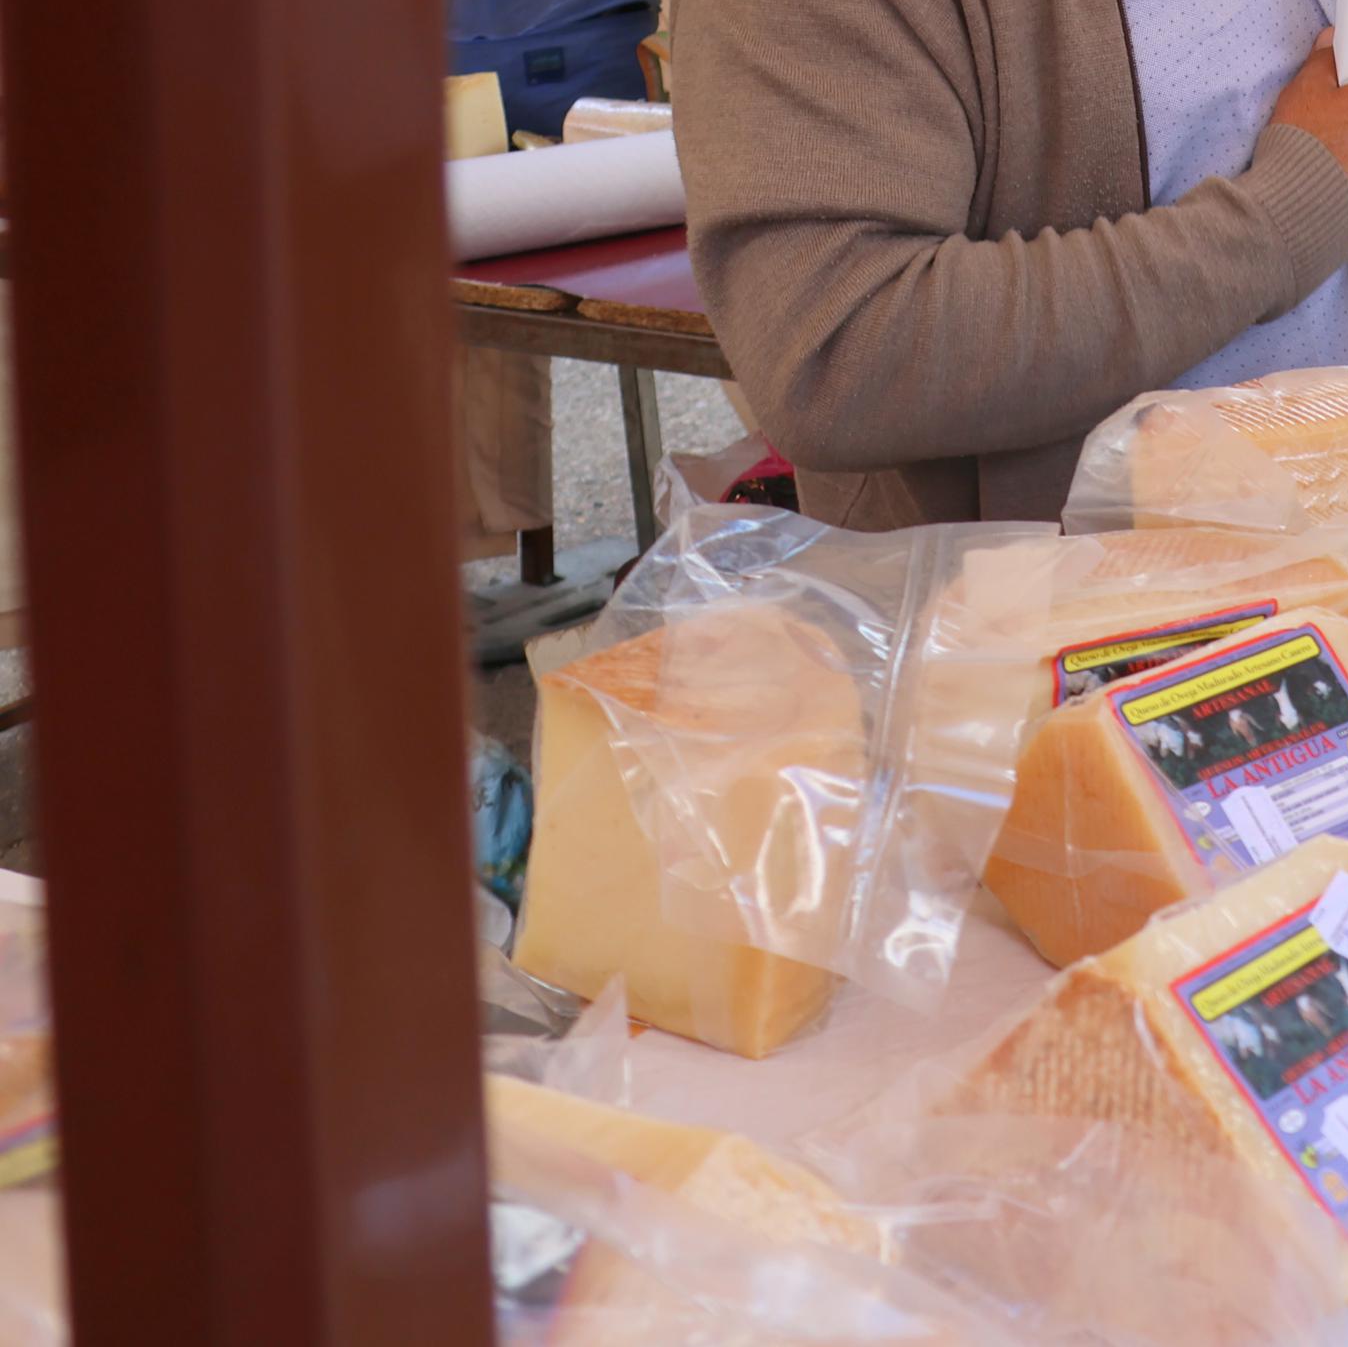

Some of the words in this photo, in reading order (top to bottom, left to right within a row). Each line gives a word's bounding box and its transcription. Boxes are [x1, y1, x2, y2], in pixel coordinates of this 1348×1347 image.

[1204, 771, 1241, 801] LA
[1242, 735, 1338, 785] ANTIGUA
[1292, 1075, 1329, 1104] LA
